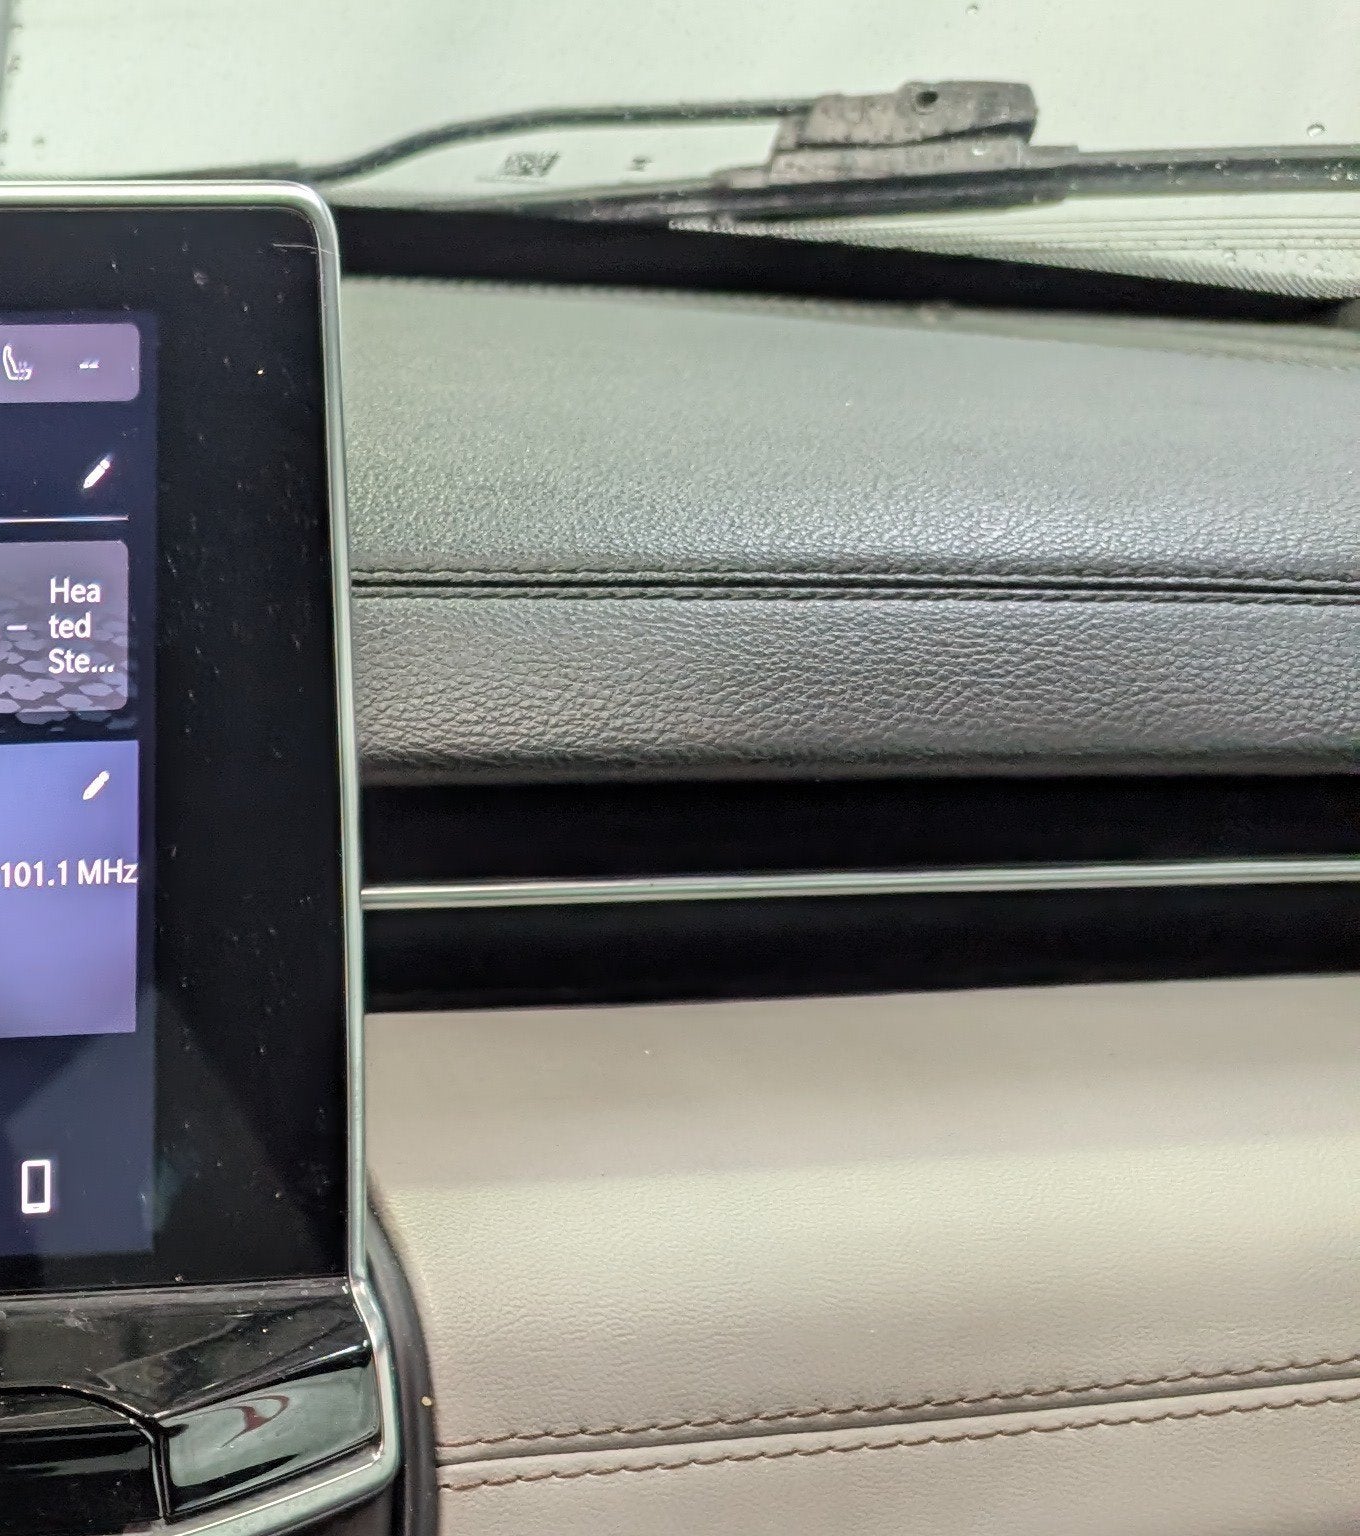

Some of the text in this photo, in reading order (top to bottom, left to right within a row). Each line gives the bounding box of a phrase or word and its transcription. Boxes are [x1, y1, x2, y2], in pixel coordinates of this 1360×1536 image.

[51, 577, 101, 603] Hea
[49, 611, 91, 638] ted
[1, 858, 138, 887] 101.1 MHz
